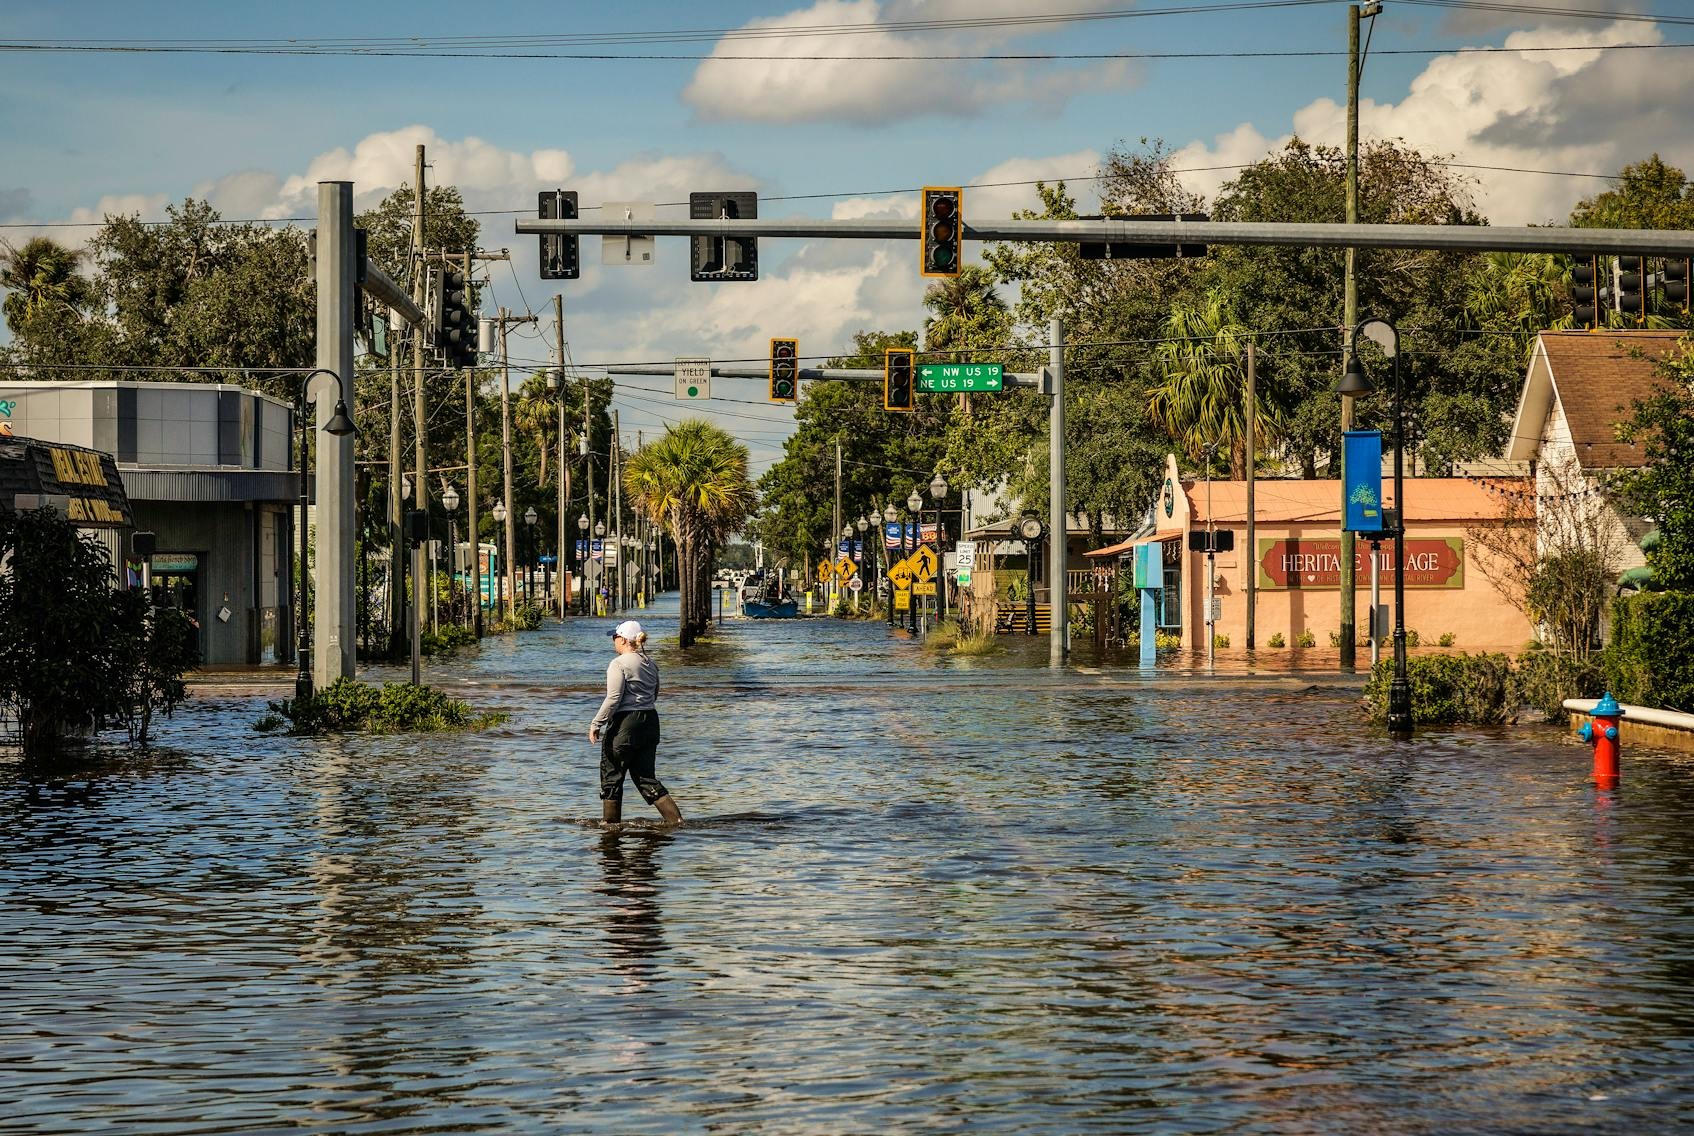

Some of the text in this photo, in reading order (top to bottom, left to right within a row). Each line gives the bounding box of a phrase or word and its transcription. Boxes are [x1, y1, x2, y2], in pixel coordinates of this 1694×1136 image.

[681, 367, 704, 377] YIELD
[943, 367, 999, 376] NW US 19
[920, 379, 974, 388] NE US 19
[958, 555, 972, 564] 25
[1281, 552, 1440, 572] HERITAE ILAGE
[1416, 574, 1434, 582] RIVER
